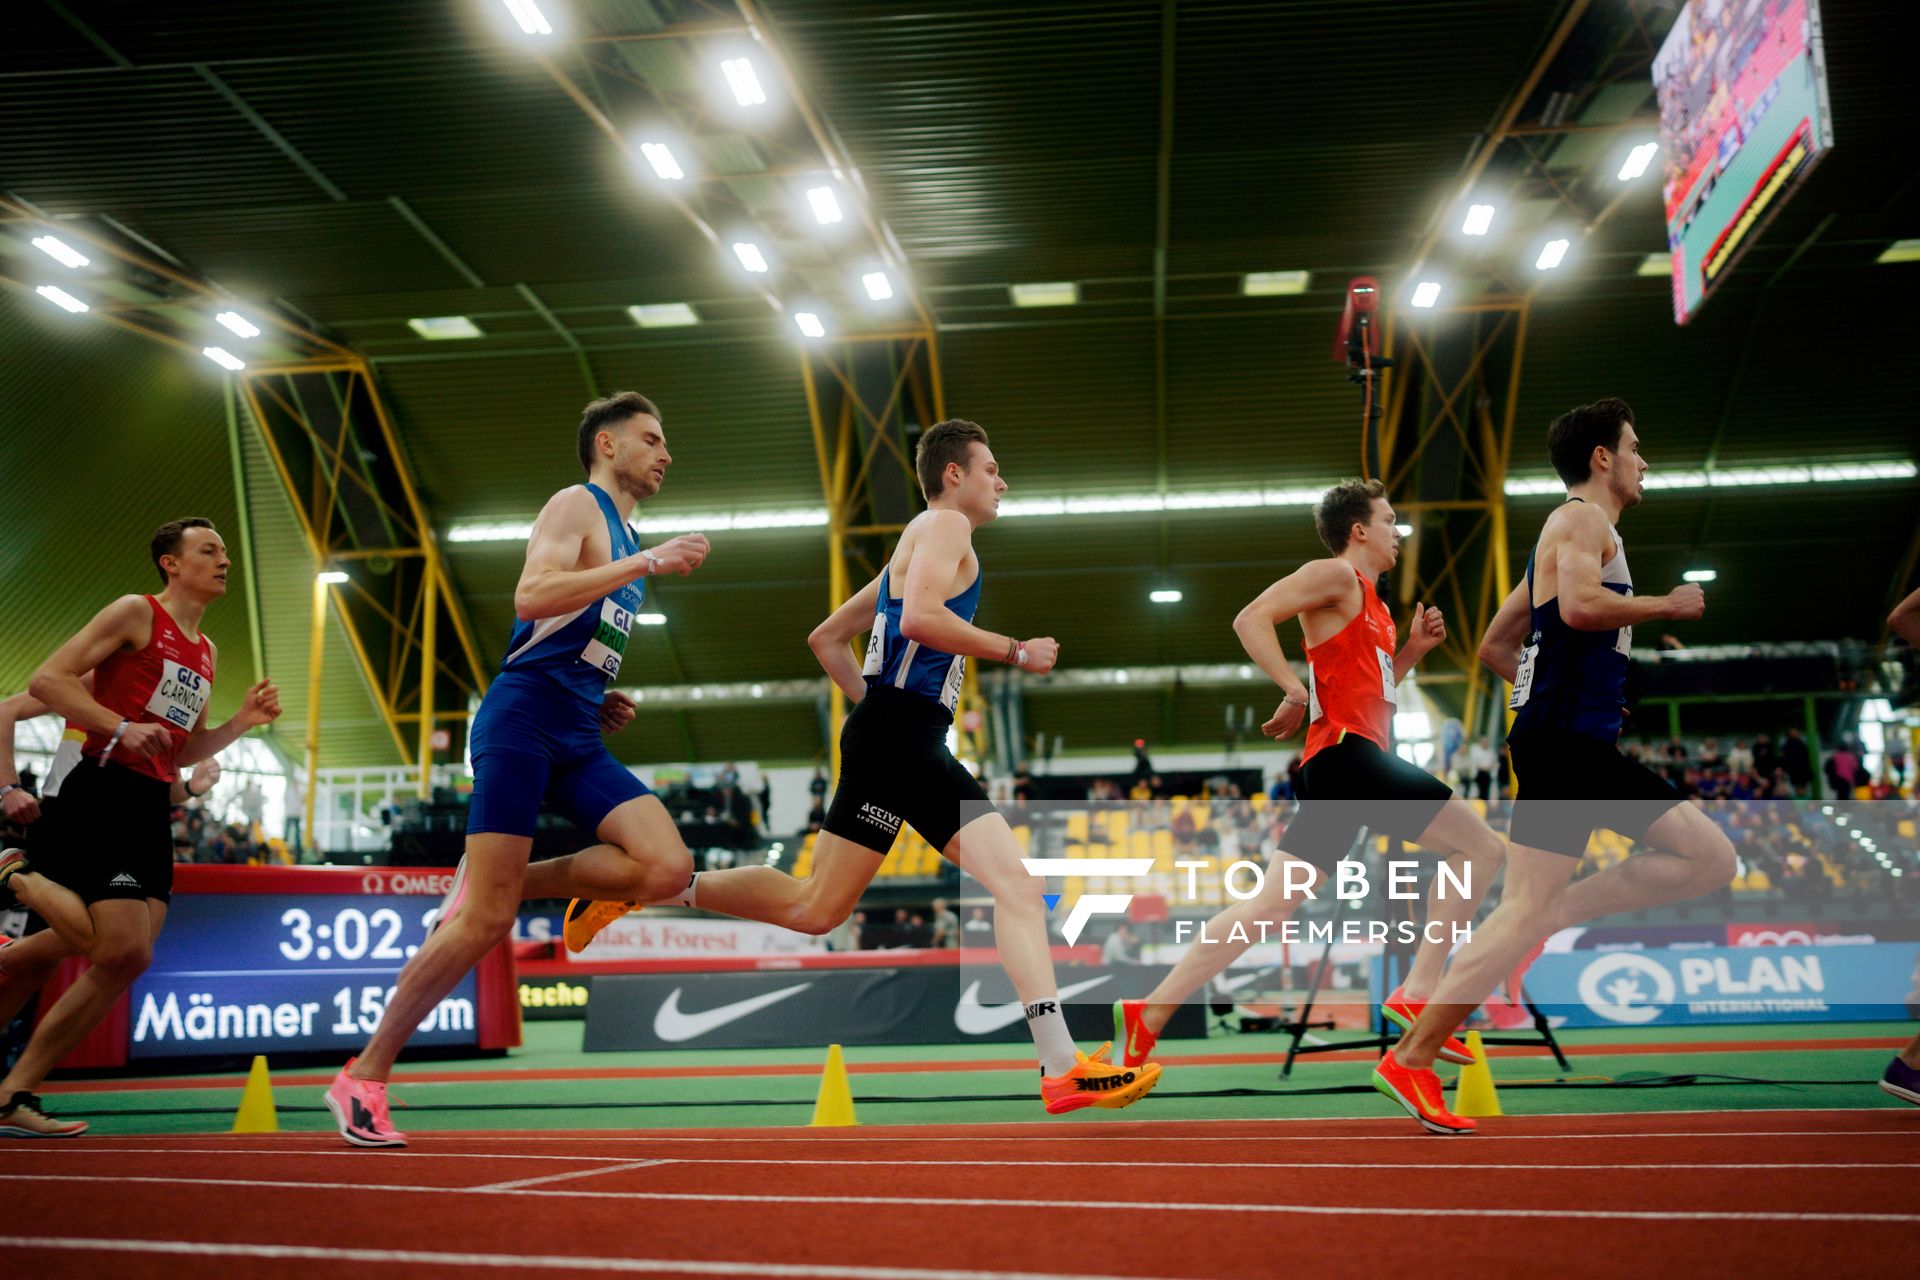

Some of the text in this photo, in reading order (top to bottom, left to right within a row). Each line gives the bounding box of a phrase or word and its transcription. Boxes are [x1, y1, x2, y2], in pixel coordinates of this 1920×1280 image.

[177, 667, 201, 691] GLS
[161, 679, 204, 713] C.ARNOLD
[596, 926, 655, 948] lack
[661, 926, 738, 950] Forest
[1680, 955, 1824, 995] PLAN
[134, 992, 320, 1042] Männer
[1689, 998, 1830, 1014] INTERNATIONAL
[1072, 1071, 1135, 1091] NITRO
